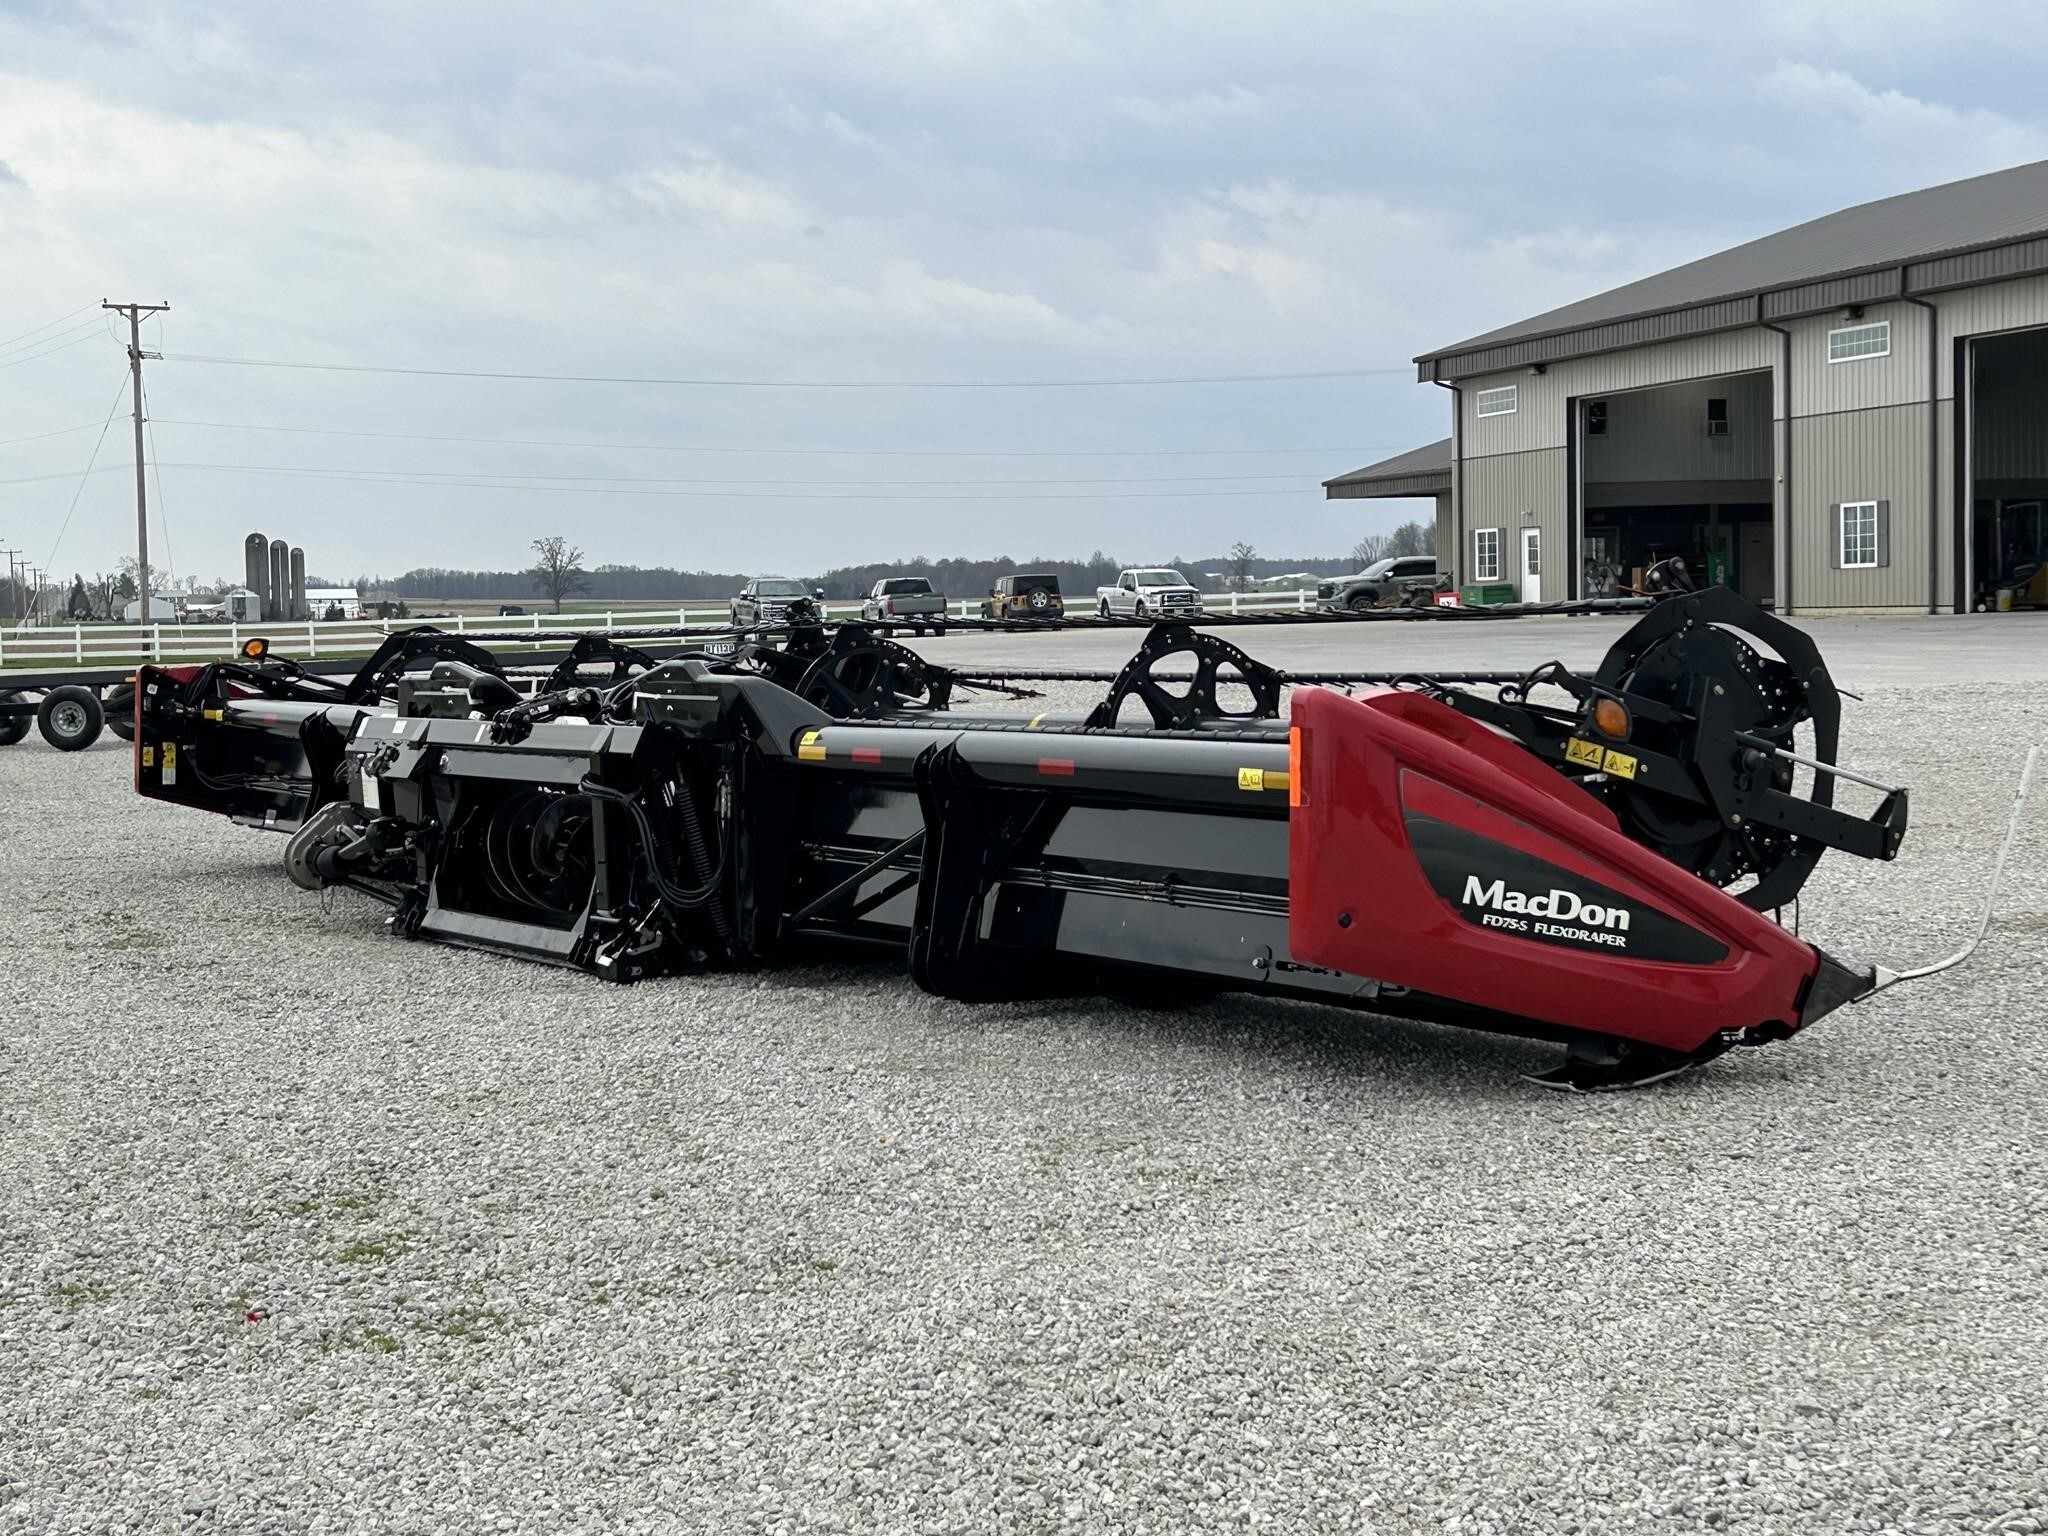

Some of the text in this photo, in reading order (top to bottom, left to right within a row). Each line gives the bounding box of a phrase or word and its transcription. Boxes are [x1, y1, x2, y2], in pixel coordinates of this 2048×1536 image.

[1462, 875, 1631, 931] MacDon
[1482, 914, 1626, 947] FD75-S FLEXDRAPER
